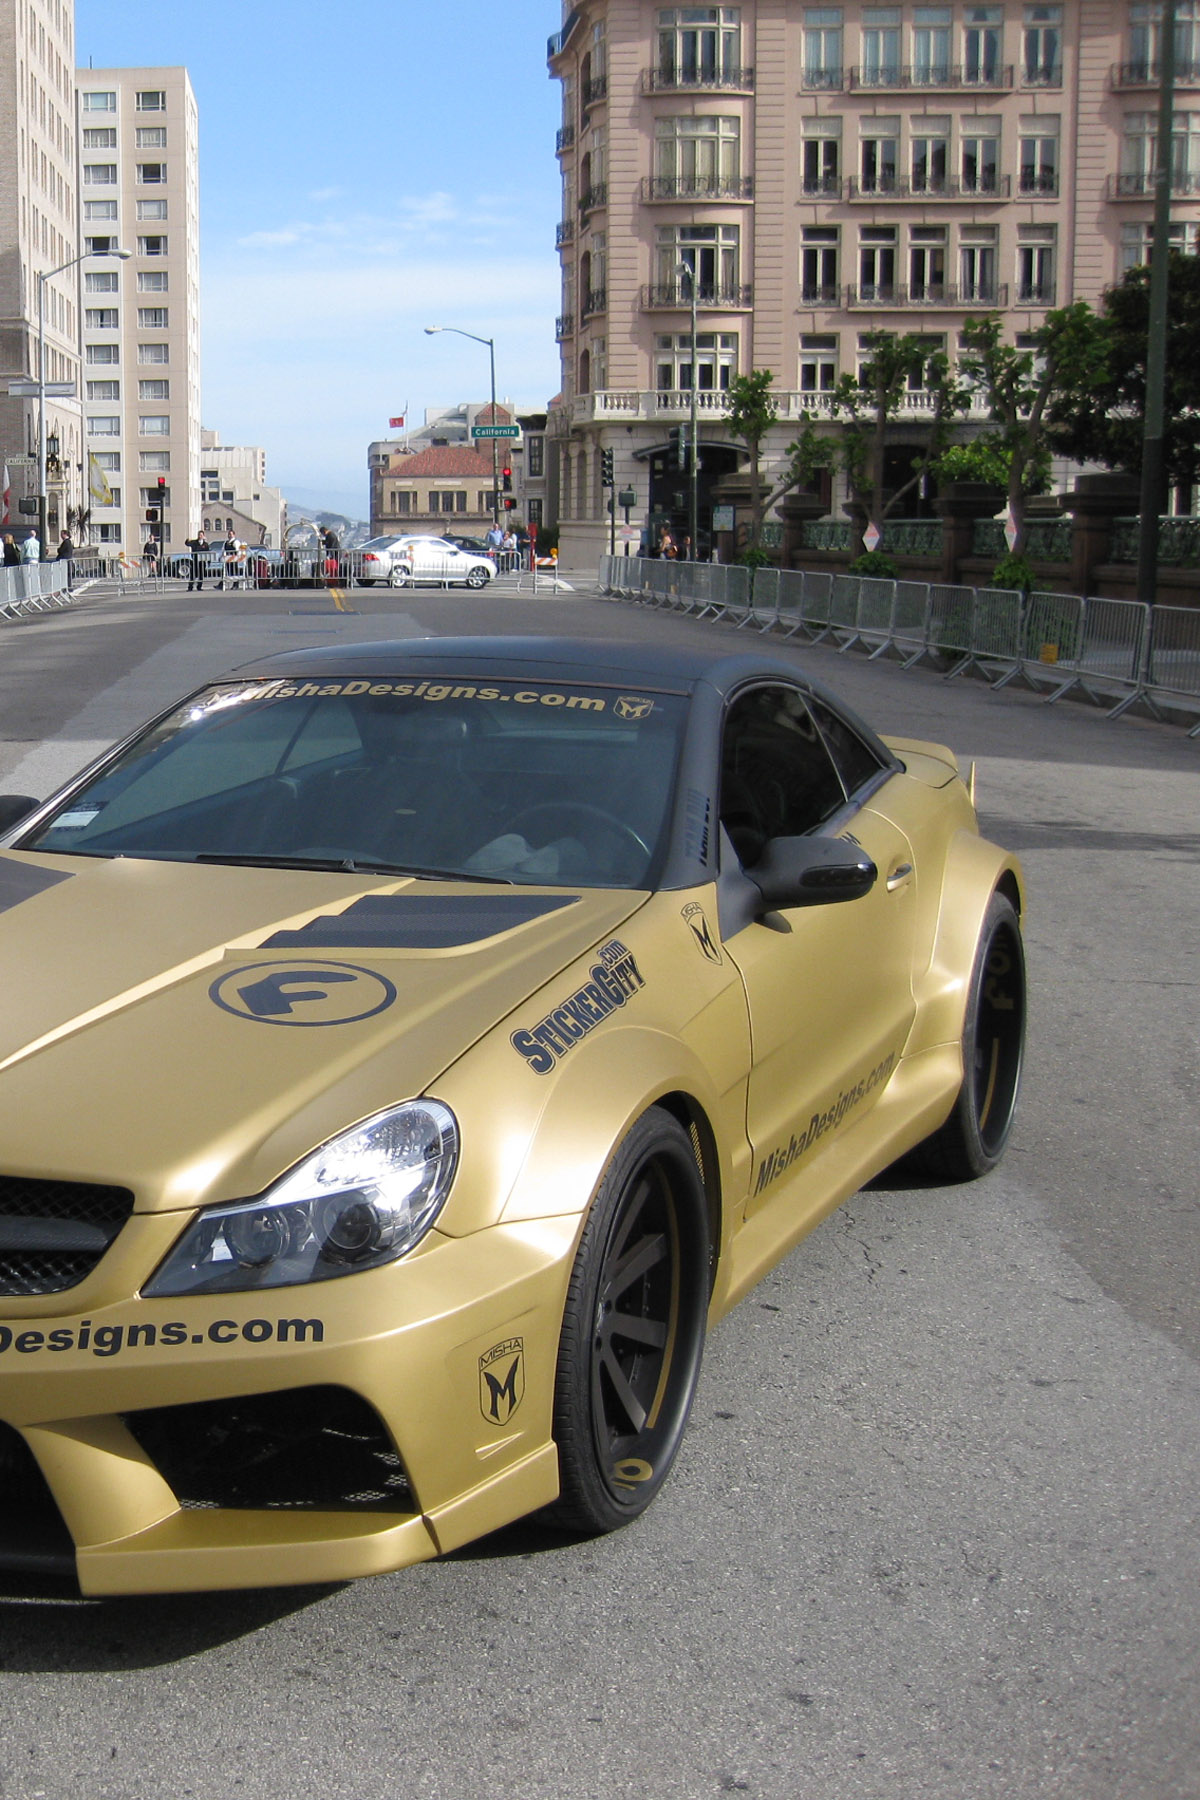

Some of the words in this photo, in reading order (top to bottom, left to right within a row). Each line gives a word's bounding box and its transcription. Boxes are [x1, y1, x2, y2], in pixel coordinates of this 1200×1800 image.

[475, 428, 516, 436] California
[753, 1051, 895, 1198] MishaDesigns.com
[481, 1340, 522, 1367] MISHA
